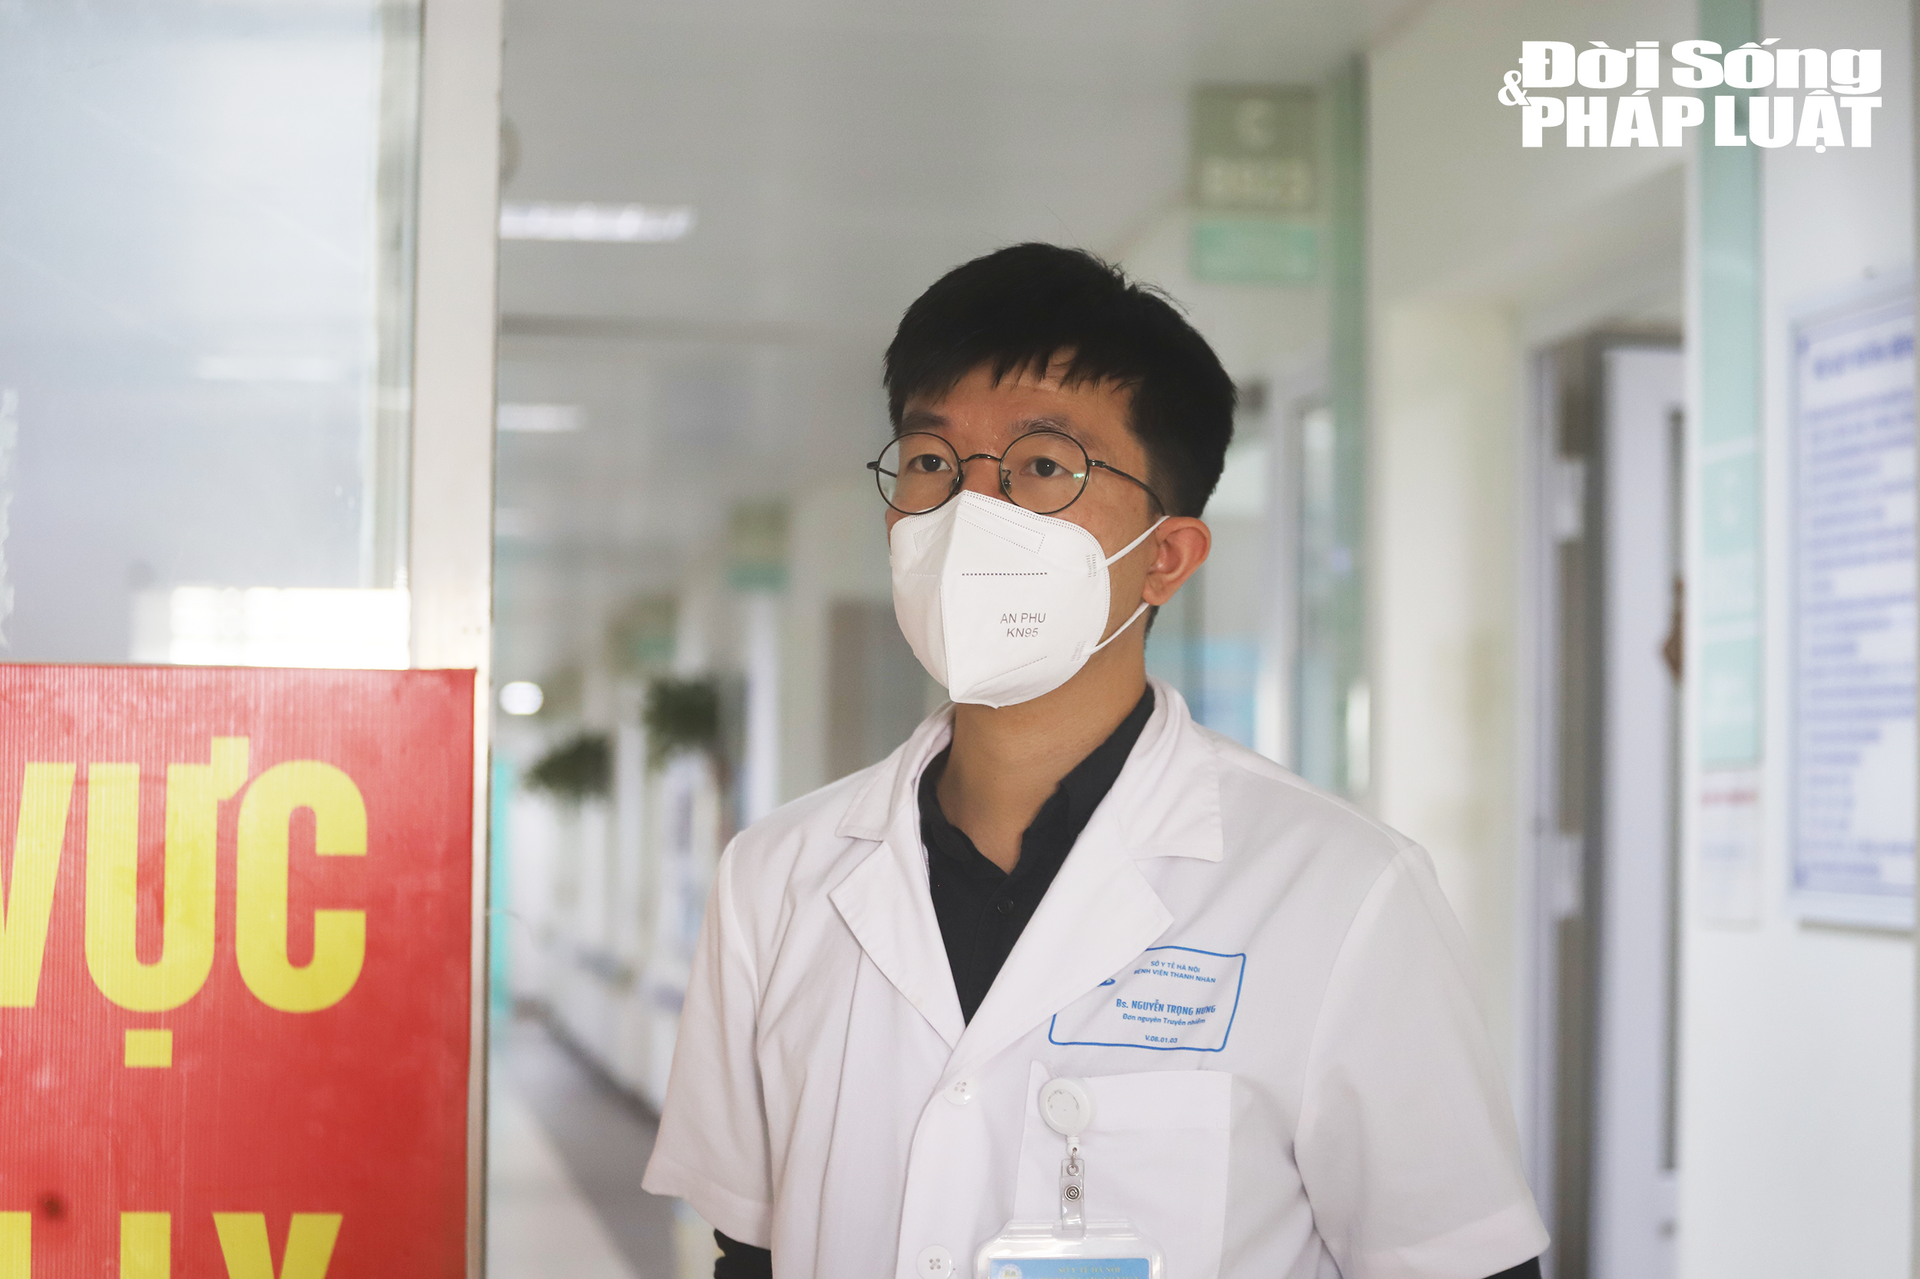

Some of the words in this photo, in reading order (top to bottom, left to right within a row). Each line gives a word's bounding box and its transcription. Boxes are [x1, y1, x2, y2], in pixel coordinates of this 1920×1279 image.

[1000, 613, 1017, 624] AN
[1020, 612, 1046, 624] PHU
[1006, 627, 1039, 638] KN95
[0, 736, 368, 1068] VỰC
[1170, 972, 1194, 980] THANH
[1116, 998, 1128, 1008] Bs.
[1132, 999, 1164, 1012] NGUYỄN
[1167, 1004, 1194, 1016] TRỌNG
